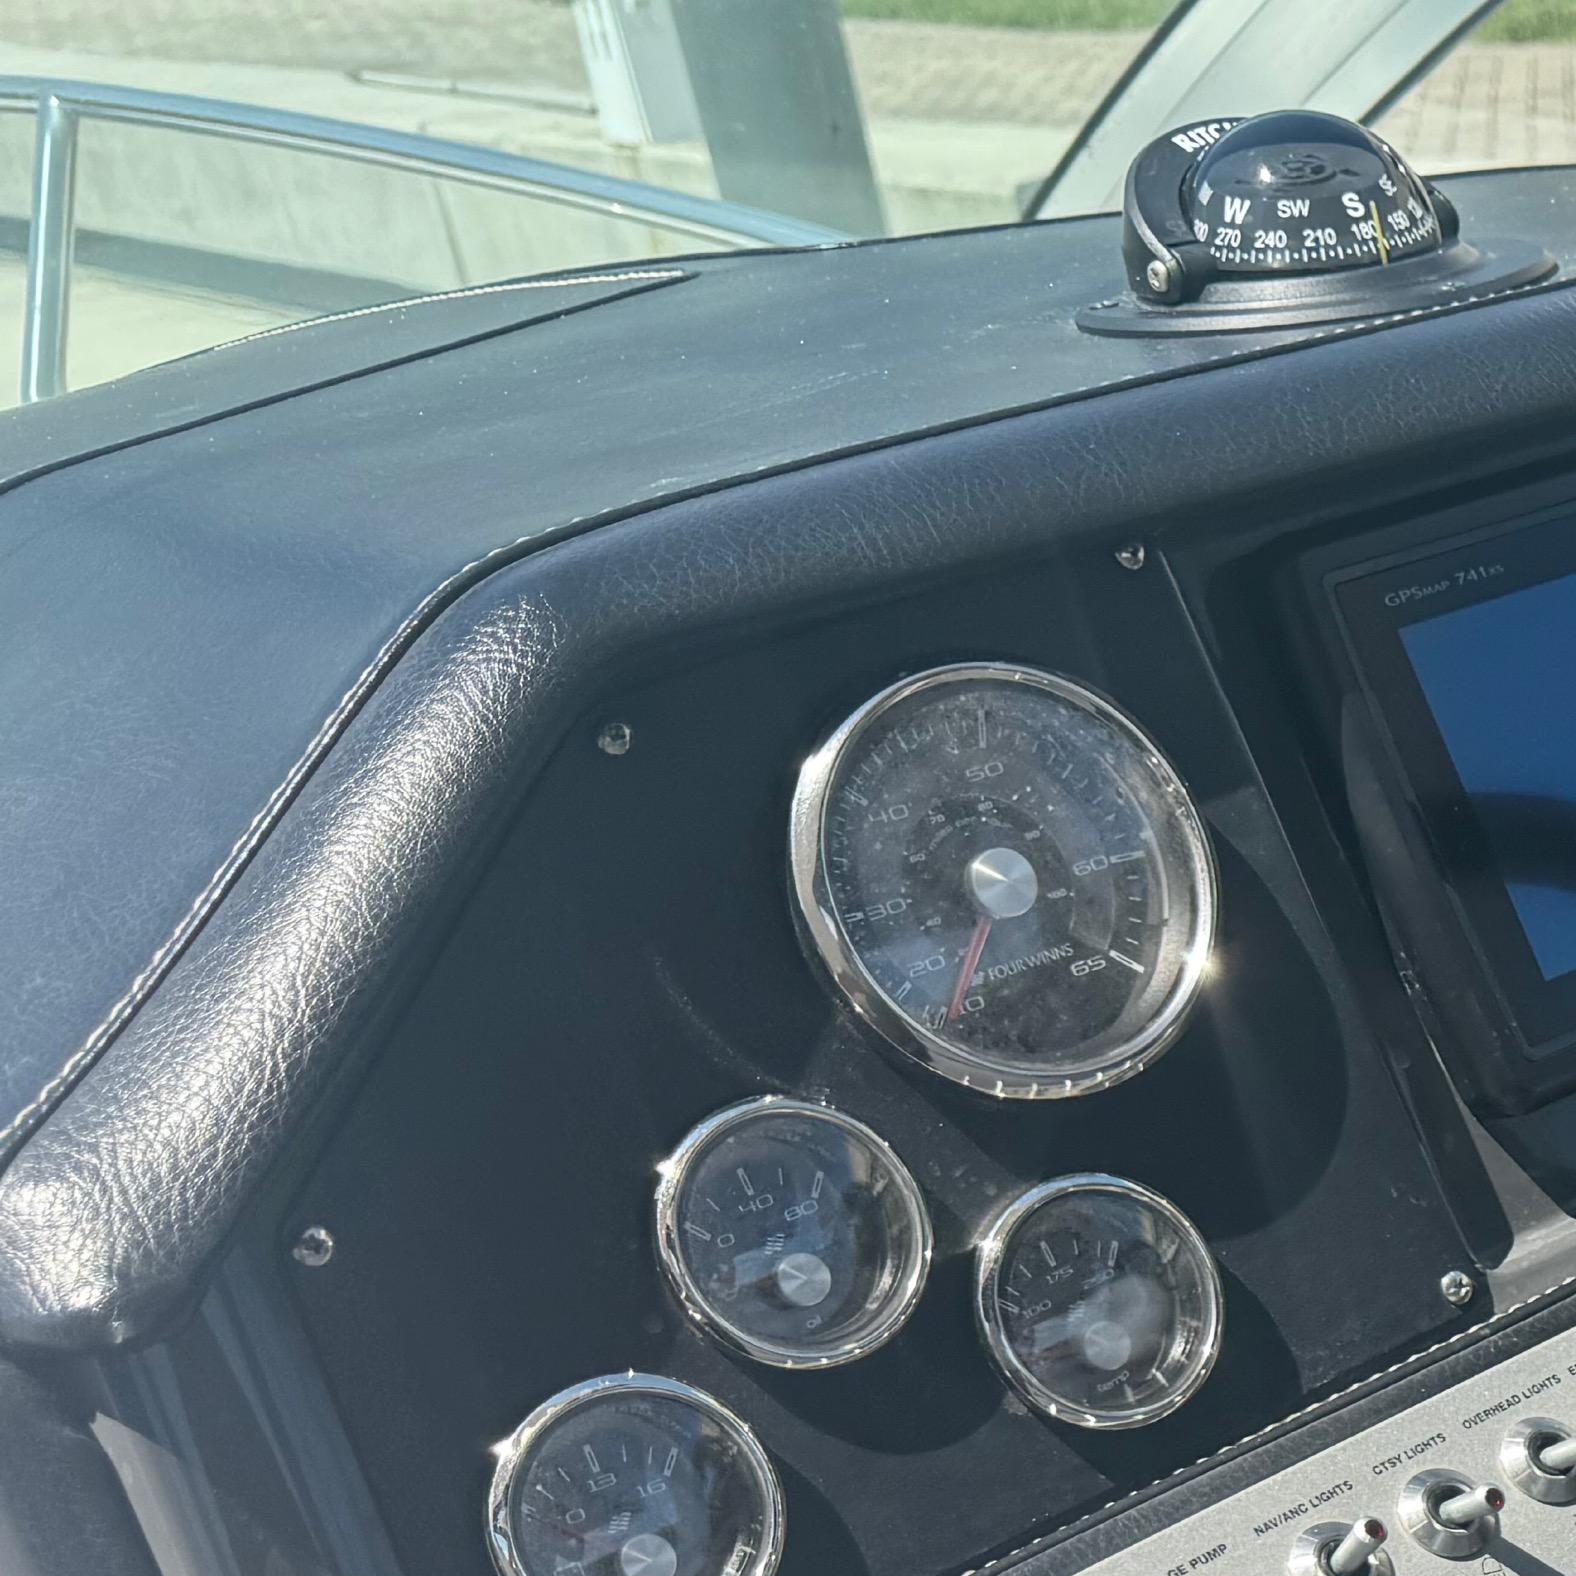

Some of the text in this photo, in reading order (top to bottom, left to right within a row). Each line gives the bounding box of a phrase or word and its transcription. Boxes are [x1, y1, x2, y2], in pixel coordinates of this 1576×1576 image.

[1224, 196, 1252, 225] W
[1277, 199, 1310, 218] SW
[1342, 192, 1366, 218] S
[1214, 226, 1241, 248] 270
[1254, 228, 1287, 249] 240
[1303, 226, 1337, 247] 210
[1351, 220, 1378, 241] 180
[966, 762, 1004, 783] 50
[868, 803, 909, 823] 40
[1072, 855, 1110, 876] 60
[863, 898, 908, 921] 30
[909, 955, 946, 977] 20
[988, 943, 1074, 980] FOUR WINNS
[1069, 955, 1107, 976] 65
[1462, 1374, 1562, 1431] OVERHEAD LIGHTS
[1371, 1432, 1447, 1476] CTSY LIGHTS
[1253, 1480, 1355, 1537] NAV/ANC LIGHTS
[1188, 1543, 1229, 1571] PUMP
